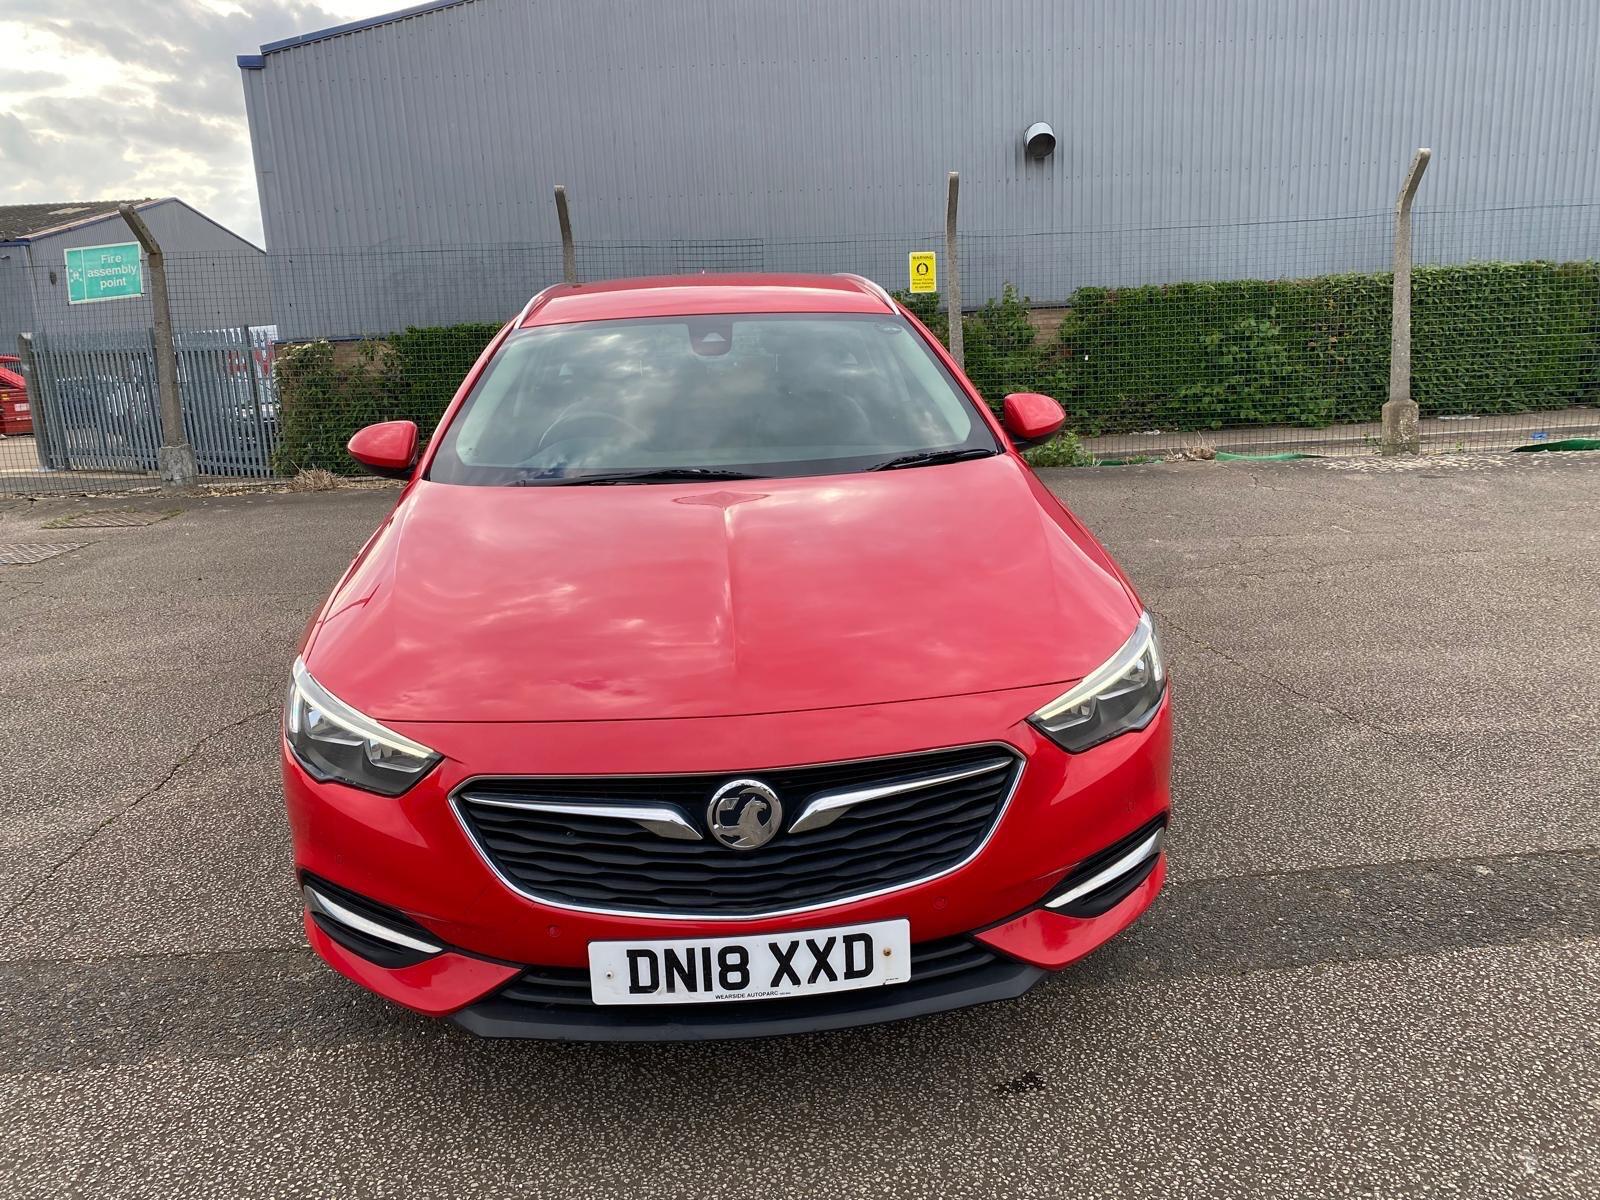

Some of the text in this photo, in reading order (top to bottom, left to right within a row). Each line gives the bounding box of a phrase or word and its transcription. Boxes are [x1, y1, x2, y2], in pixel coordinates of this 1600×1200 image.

[101, 254, 122, 264] Fire
[87, 264, 137, 278] assembly
[100, 277, 127, 291] point
[626, 932, 874, 994] DN18 XXD
[715, 992, 746, 1000] WEARSIDE
[746, 990, 779, 998] AUTOPARC
